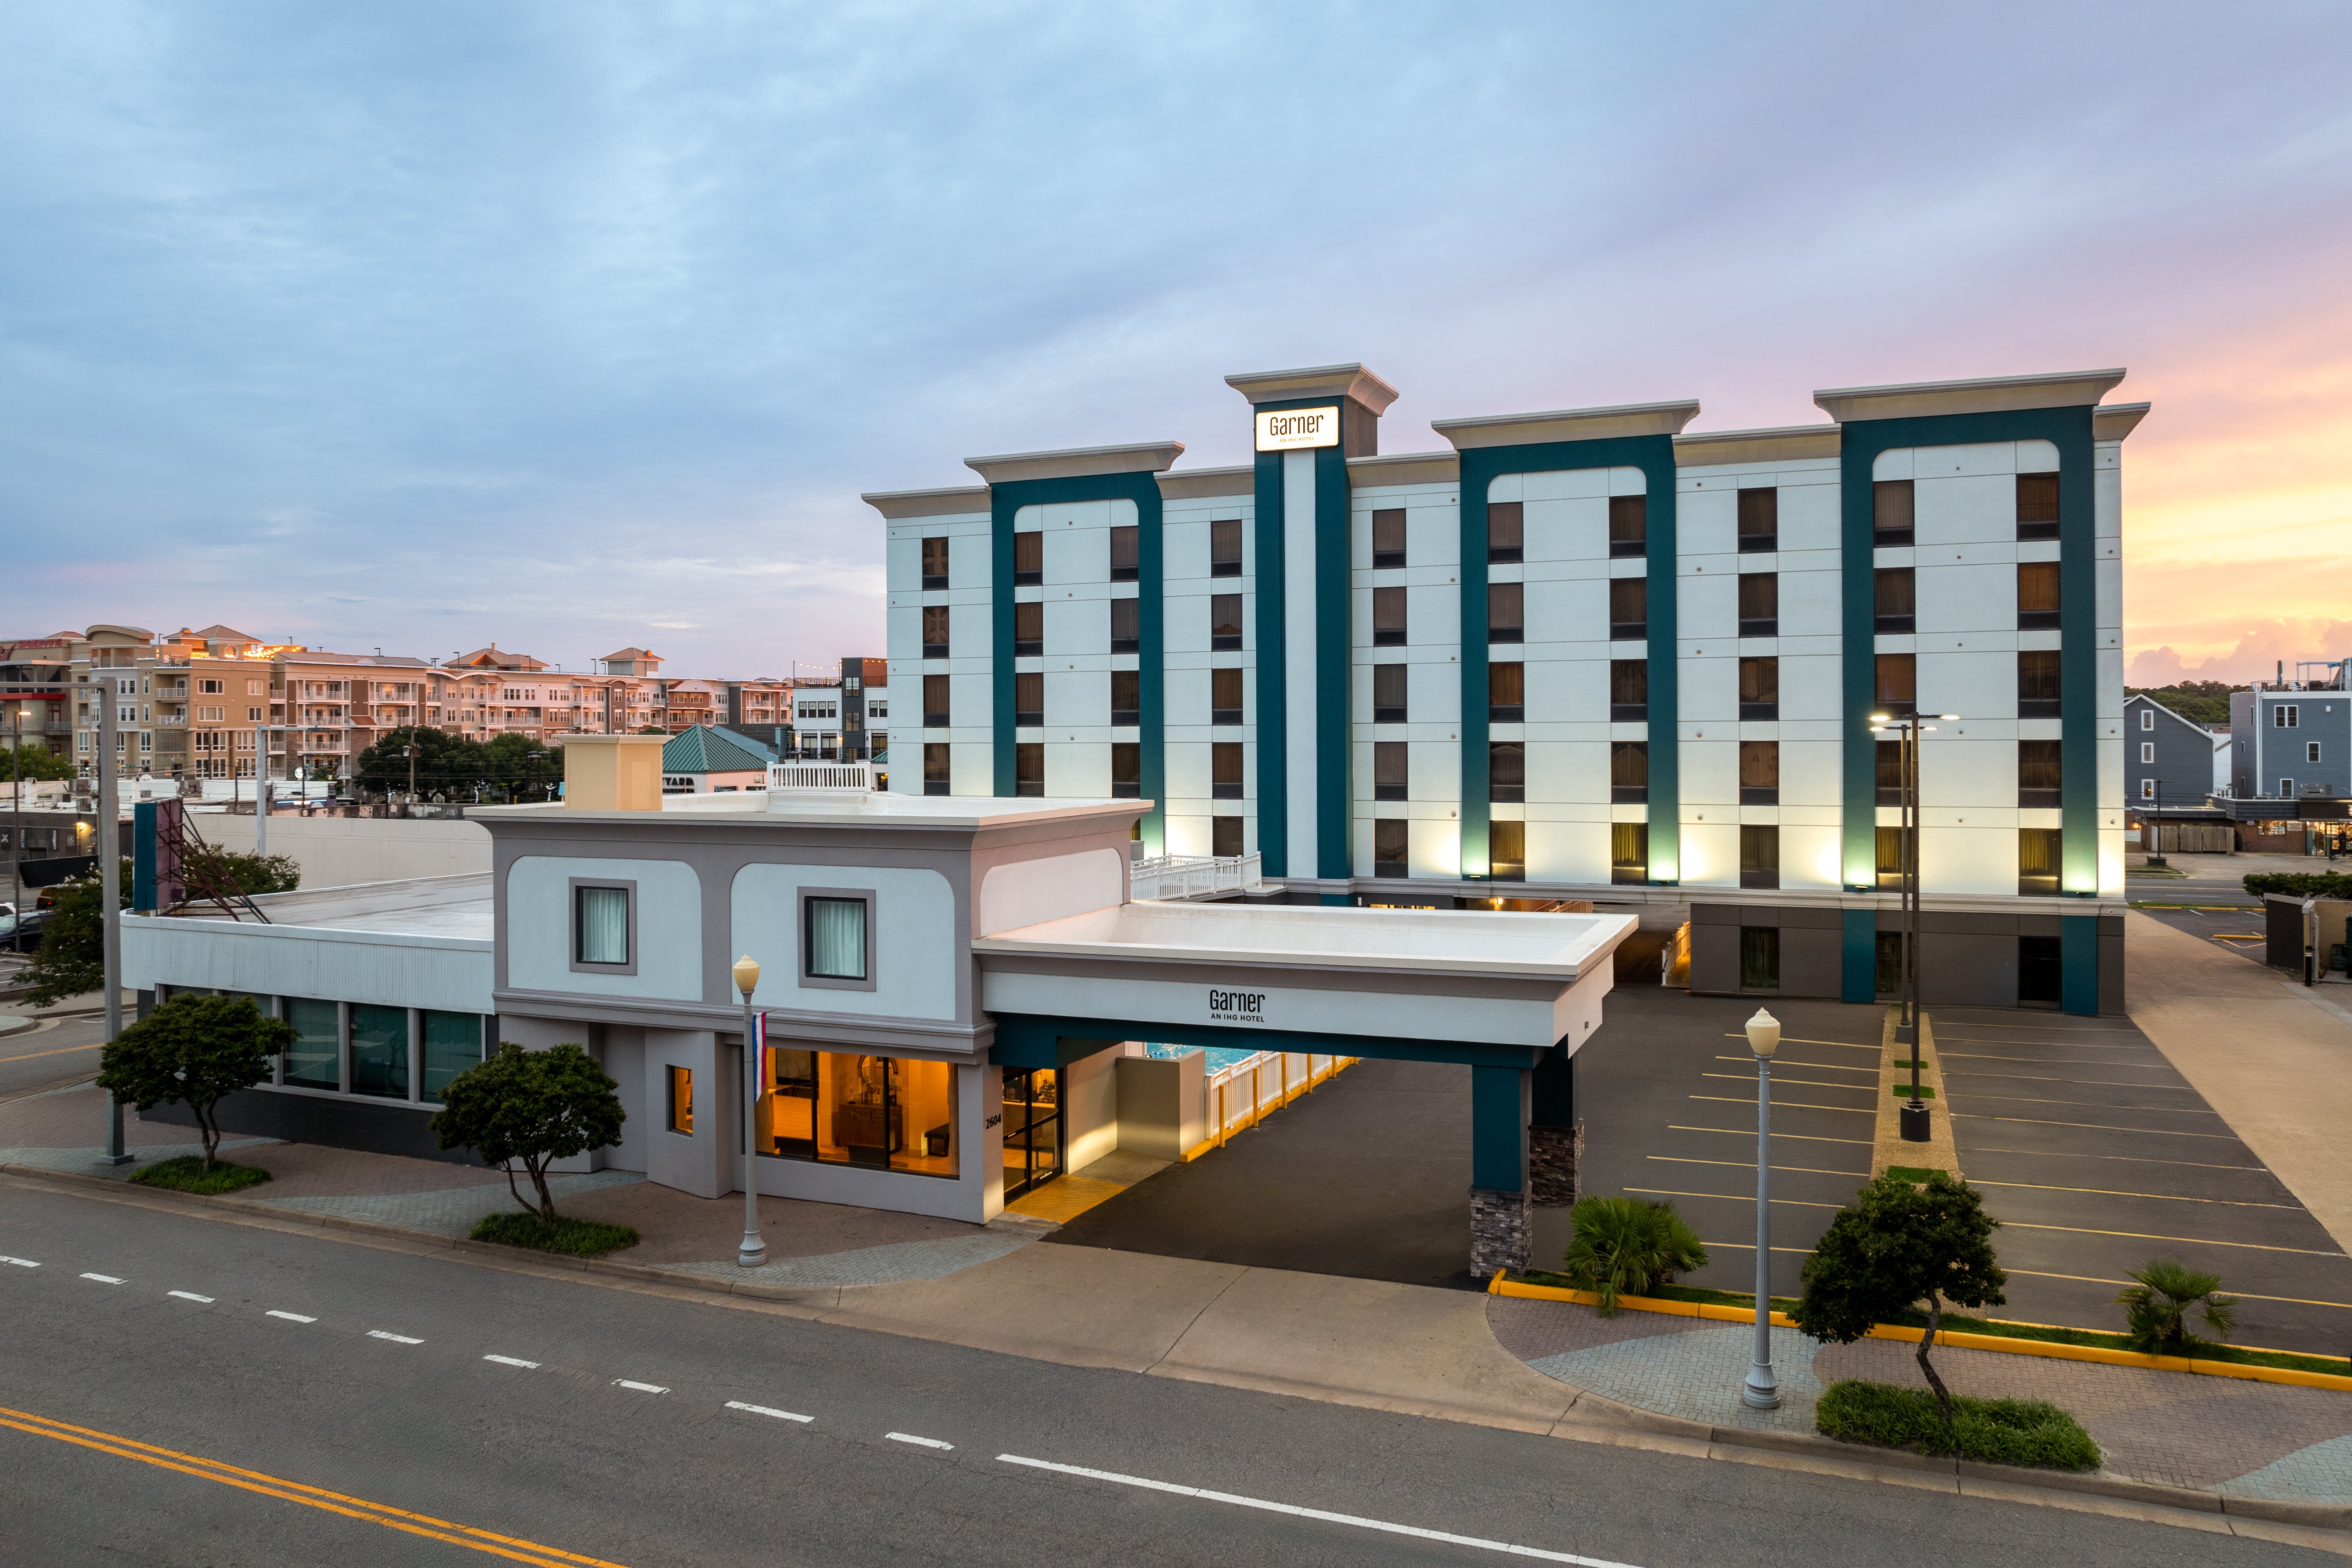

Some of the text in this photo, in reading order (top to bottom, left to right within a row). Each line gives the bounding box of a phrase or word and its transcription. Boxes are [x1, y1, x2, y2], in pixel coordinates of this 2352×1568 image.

[1270, 414, 1324, 436] Garner
[662, 777, 695, 786] YARD
[1210, 989, 1265, 1013] Garner
[985, 1113, 1001, 1130] 2604
